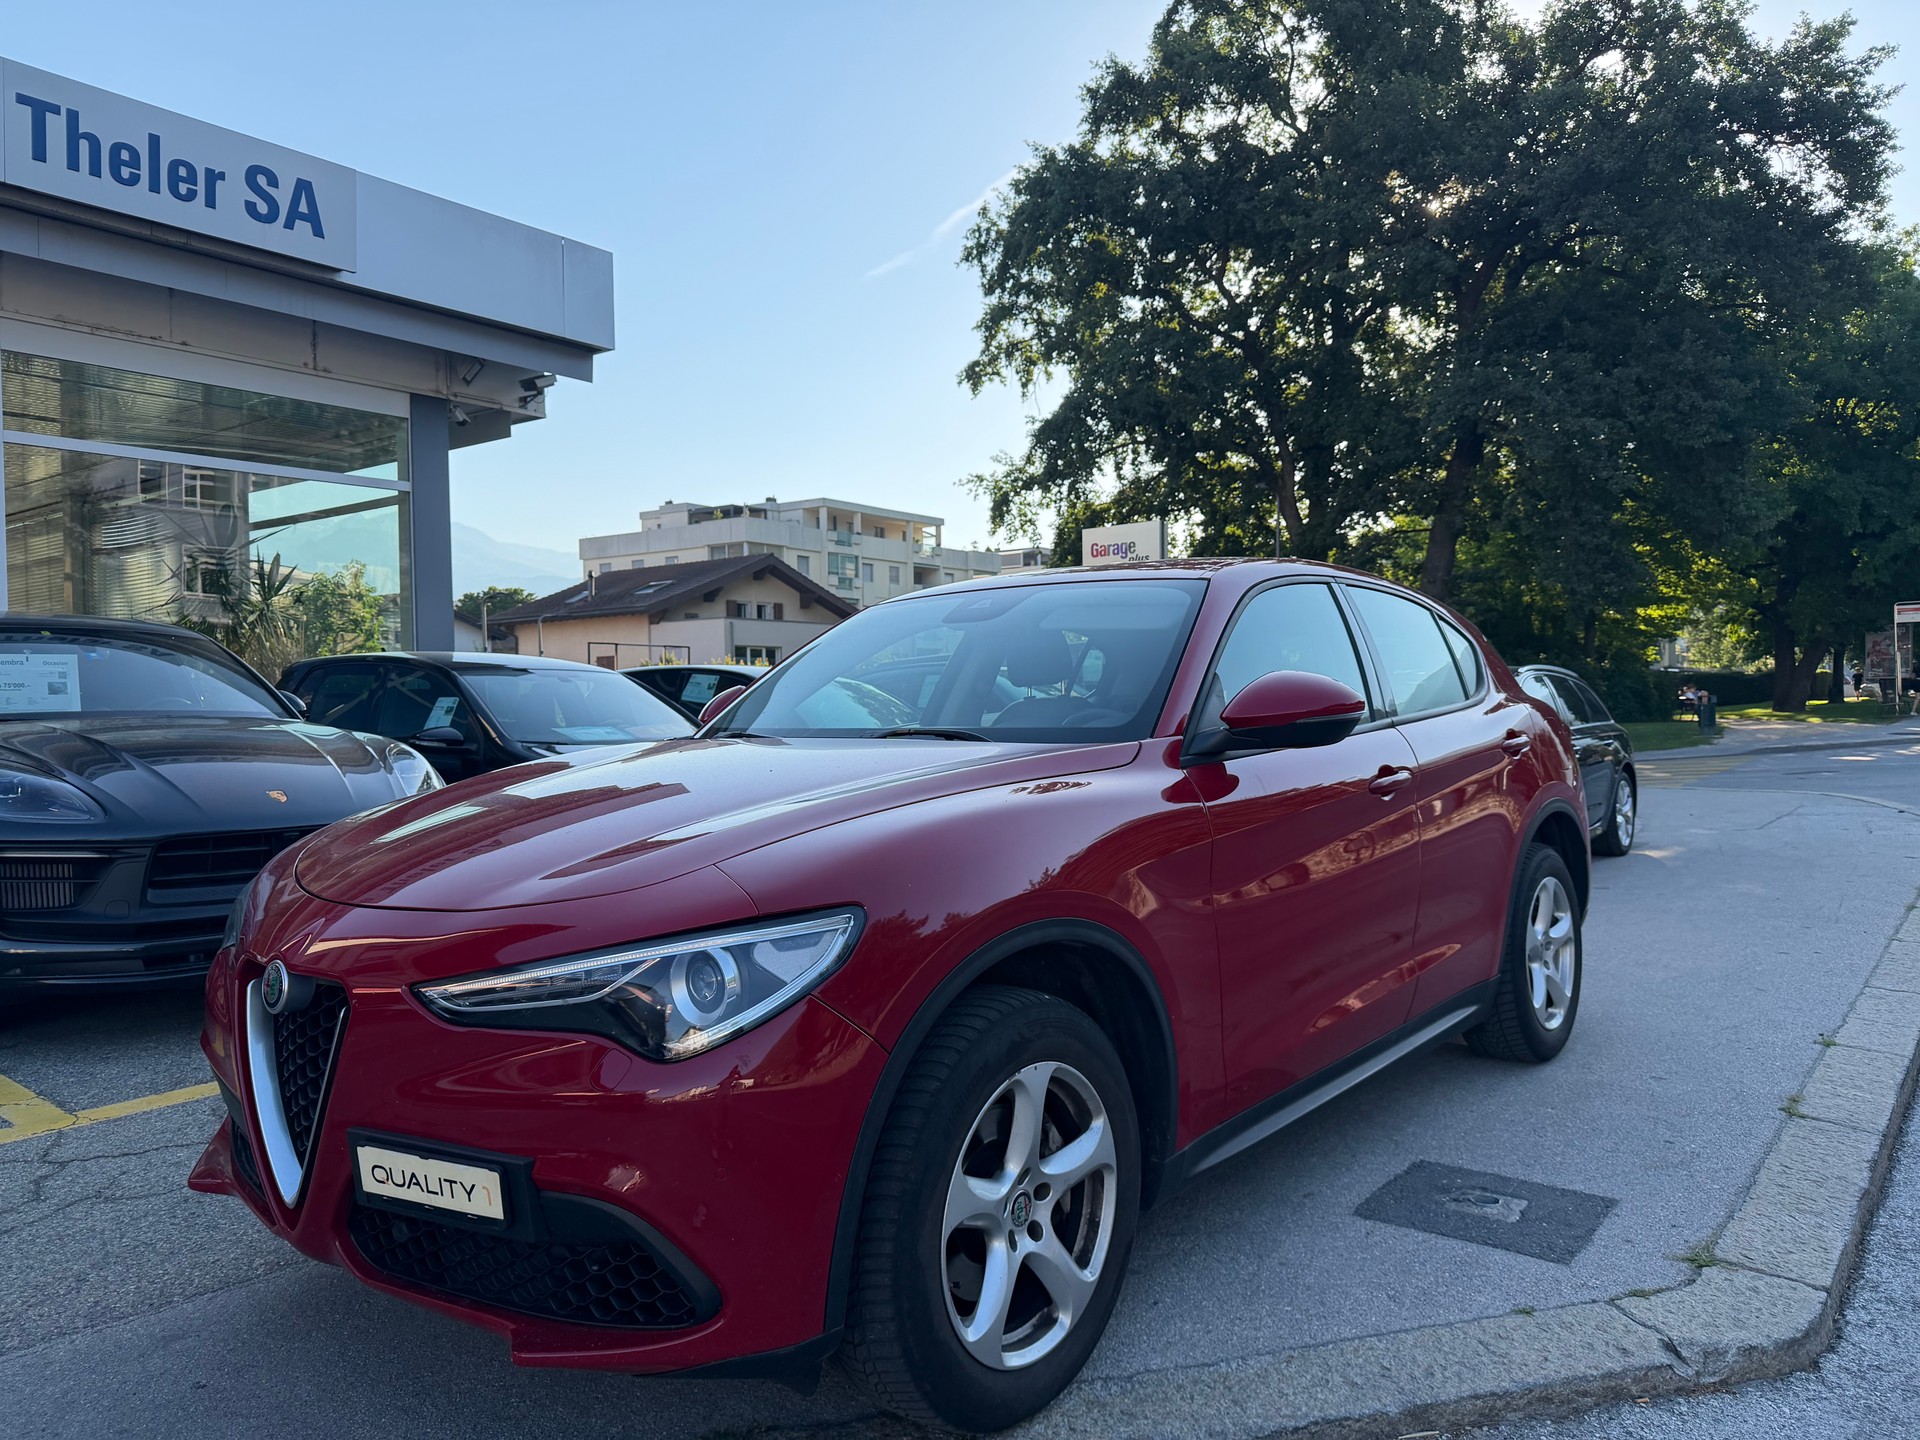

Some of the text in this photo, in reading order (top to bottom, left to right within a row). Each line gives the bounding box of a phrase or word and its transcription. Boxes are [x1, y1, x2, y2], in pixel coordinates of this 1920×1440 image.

[15, 91, 325, 239] Theler SA
[1091, 541, 1136, 559] Garage
